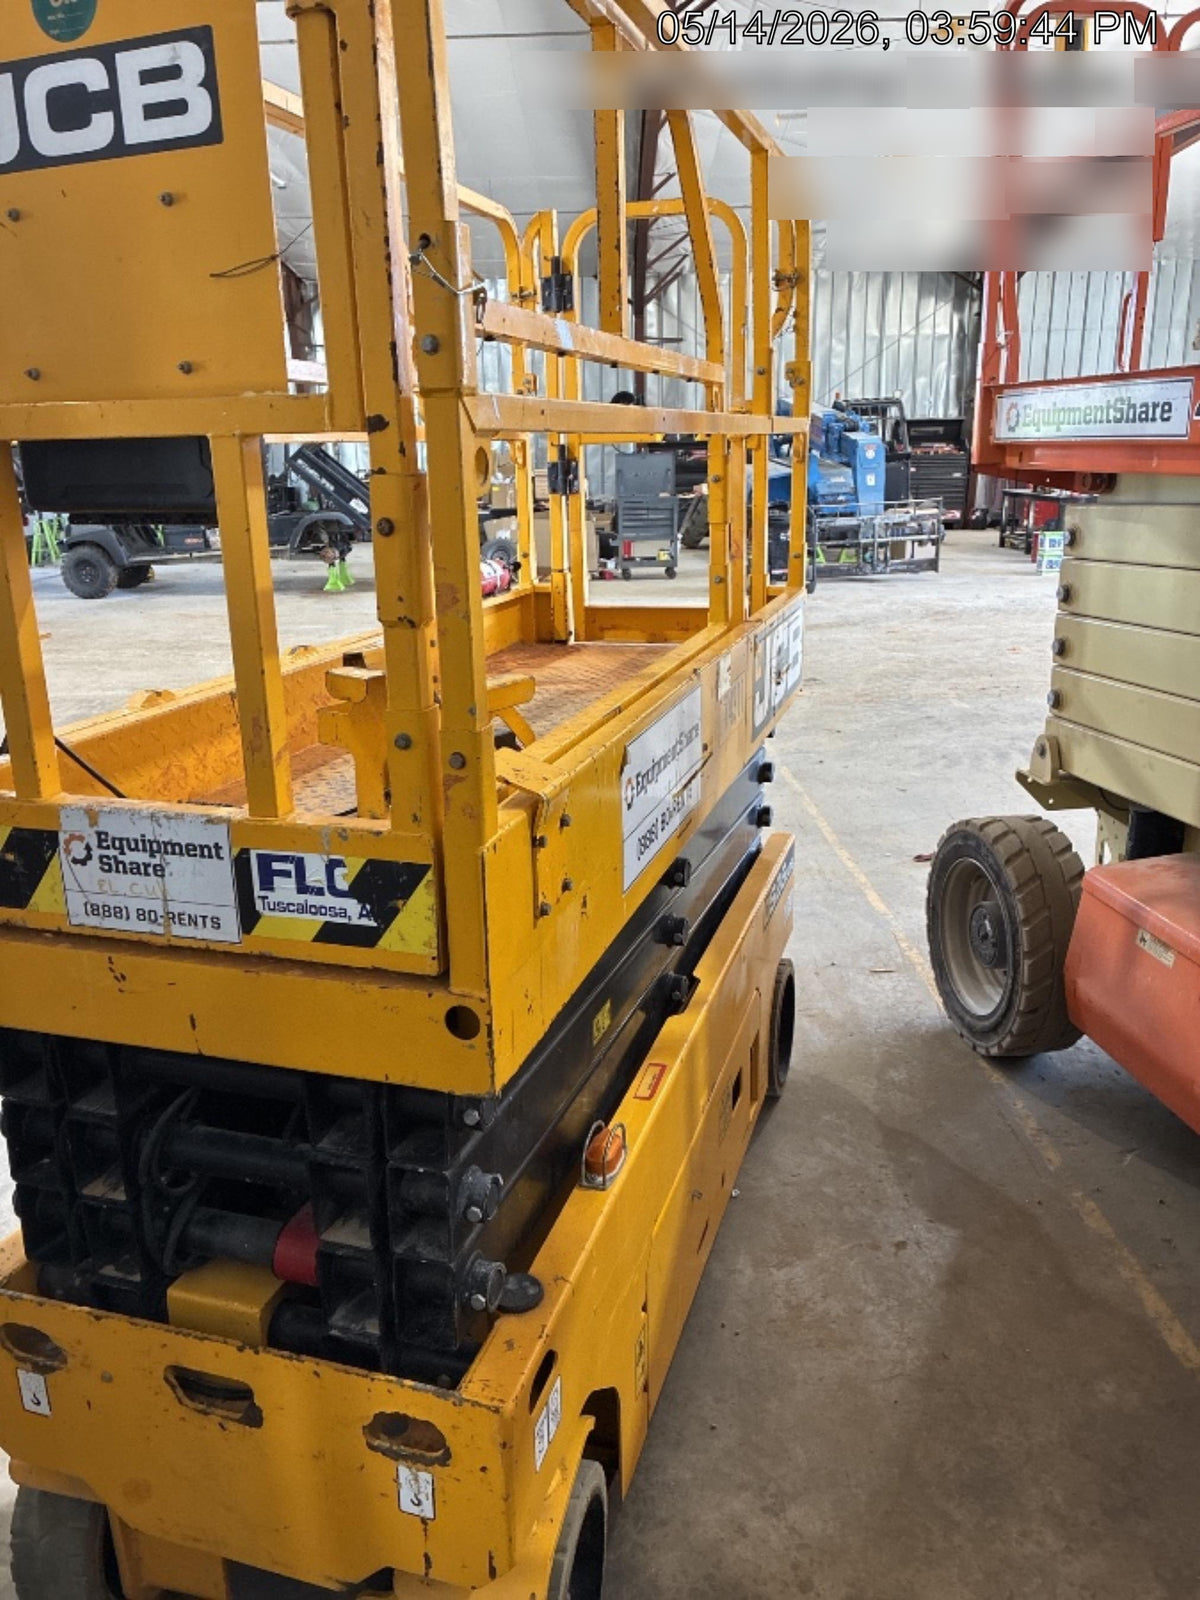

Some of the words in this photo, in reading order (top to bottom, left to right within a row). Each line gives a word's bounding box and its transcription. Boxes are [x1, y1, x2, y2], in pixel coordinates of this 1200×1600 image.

[1021, 396, 1172, 432] EquipmentShare
[95, 830, 224, 861] Equipment
[98, 854, 167, 878] Share
[83, 901, 130, 922] (888)
[136, 907, 222, 931] 80-RENTS
[257, 895, 352, 923] Tuscaloosa,
[357, 903, 374, 921] A
